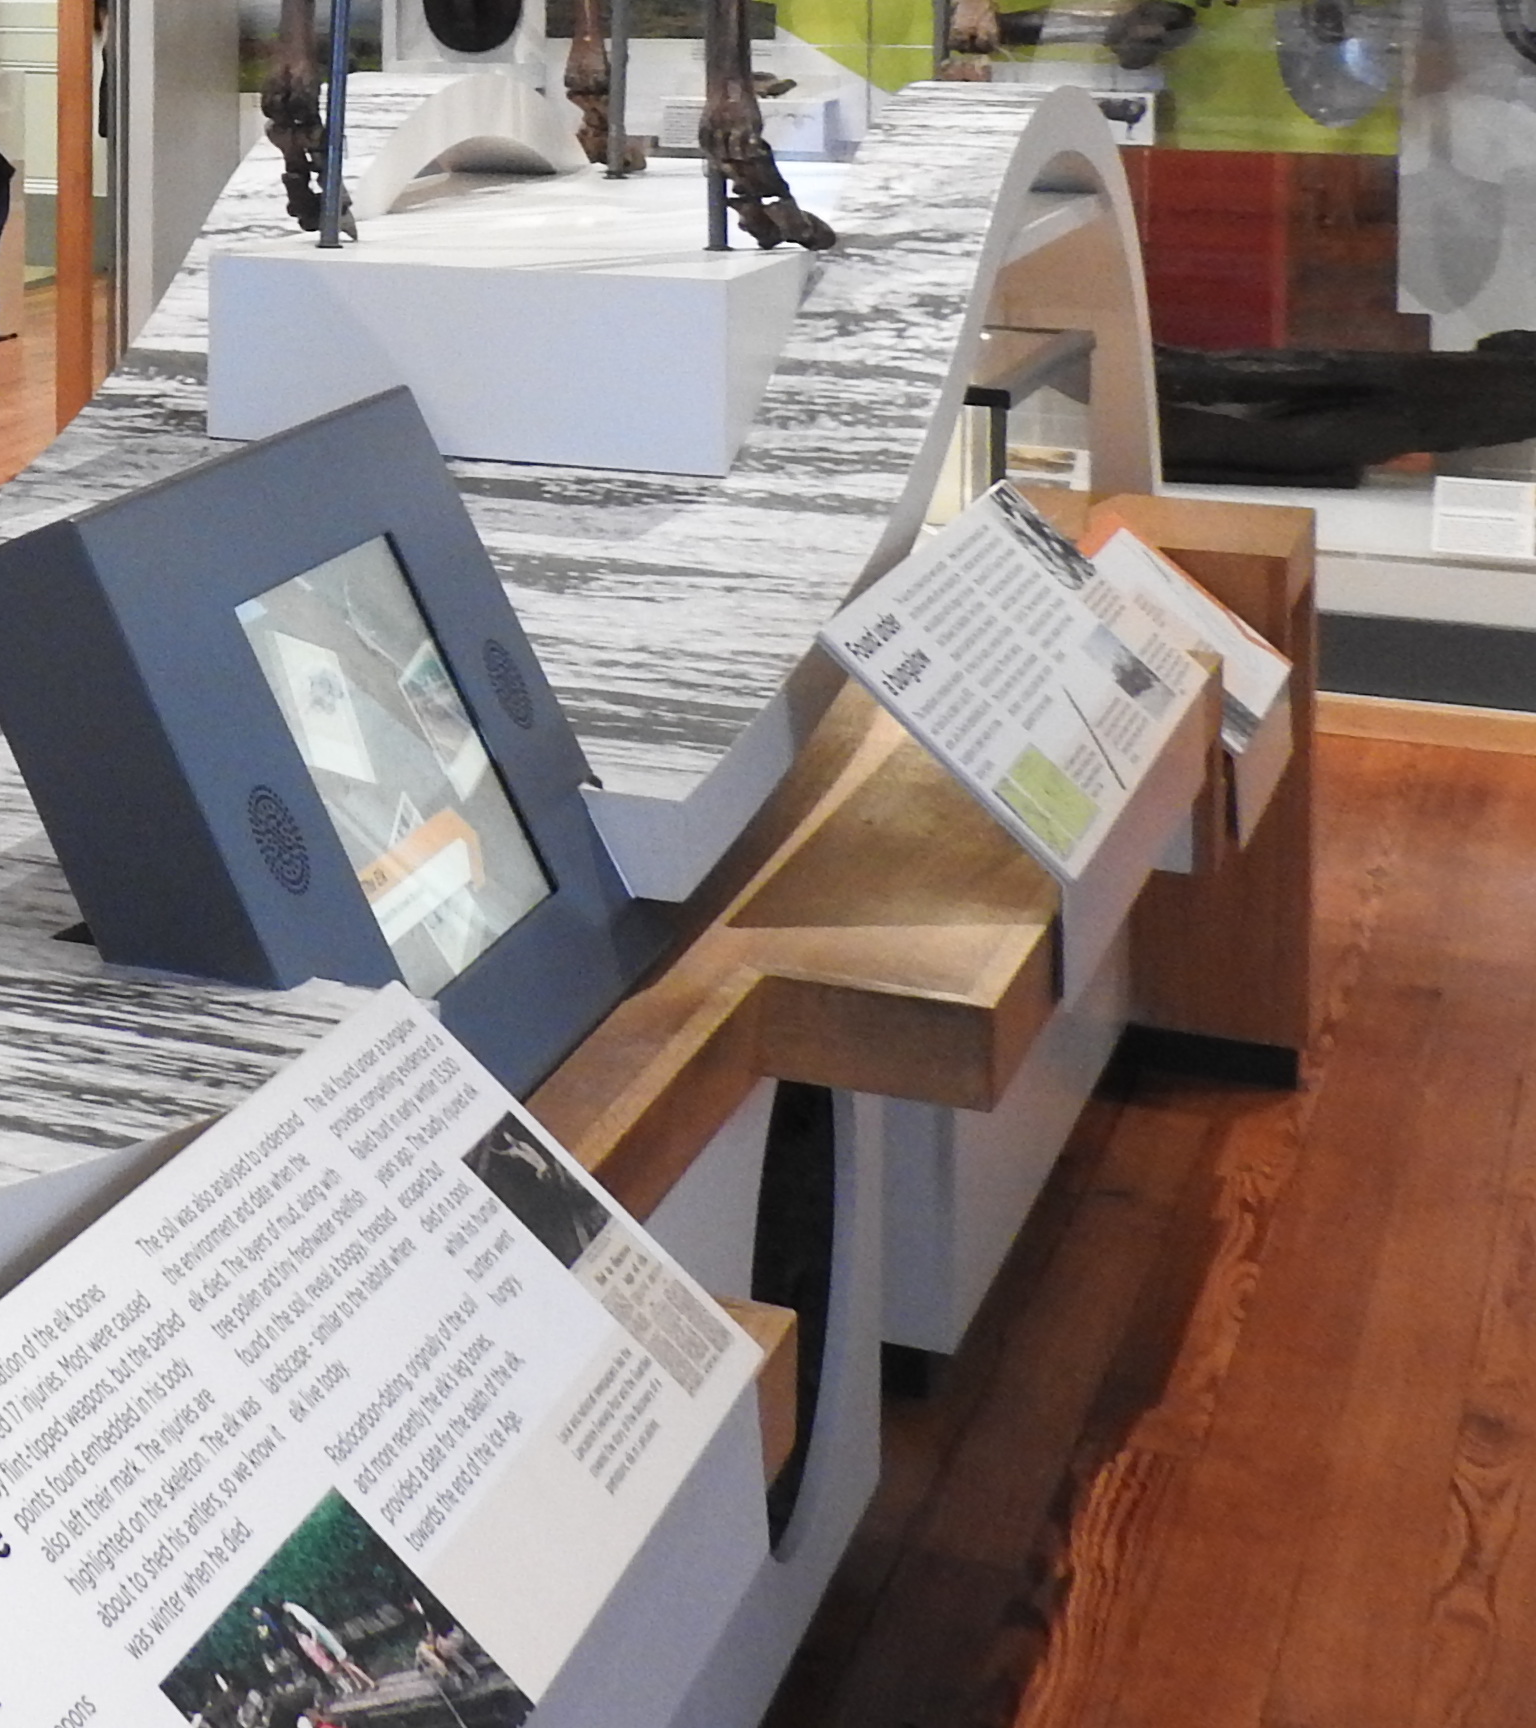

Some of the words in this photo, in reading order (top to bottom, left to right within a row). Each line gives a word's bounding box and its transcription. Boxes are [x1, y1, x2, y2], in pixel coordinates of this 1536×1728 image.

[21, 1334, 39, 1360] of
[31, 1324, 59, 1349] the
[52, 1308, 76, 1333] elk
[64, 1283, 106, 1319] bones
[2, 1399, 24, 1424] 17
[56, 1344, 93, 1377] Most
[86, 1323, 118, 1353] were
[111, 1289, 151, 1332] caused
[105, 1356, 136, 1385] but
[125, 1343, 152, 1368] the
[141, 1308, 186, 1352] barbed
[13, 1488, 55, 1535] points
[44, 1452, 87, 1496] found
[80, 1401, 141, 1466] embedded
[129, 1395, 153, 1415] in
[141, 1381, 168, 1404] his
[156, 1357, 194, 1390] body
[240, 1435, 277, 1469] know
[270, 1423, 286, 1442] it
[40, 1531, 71, 1563] also
[60, 1509, 92, 1539] left
[81, 1485, 114, 1520] their
[134, 1438, 165, 1462] The
[158, 1403, 200, 1446] injuries
[192, 1388, 216, 1413] are
[218, 1477, 238, 1499] so
[231, 1461, 253, 1483] we
[63, 1520, 135, 1596] highlighted
[128, 1510, 150, 1534] on
[139, 1492, 168, 1519] the
[160, 1451, 210, 1501] skeleton.
[199, 1429, 229, 1455] The
[221, 1413, 244, 1437] elk
[235, 1395, 262, 1422] was
[141, 1538, 174, 1580] shed
[162, 1527, 190, 1553] his
[96, 1582, 137, 1628] about
[124, 1627, 154, 1660] was
[147, 1590, 186, 1635] winter
[180, 1560, 215, 1599] when
[203, 1545, 229, 1569] he
[126, 1571, 148, 1593] to
